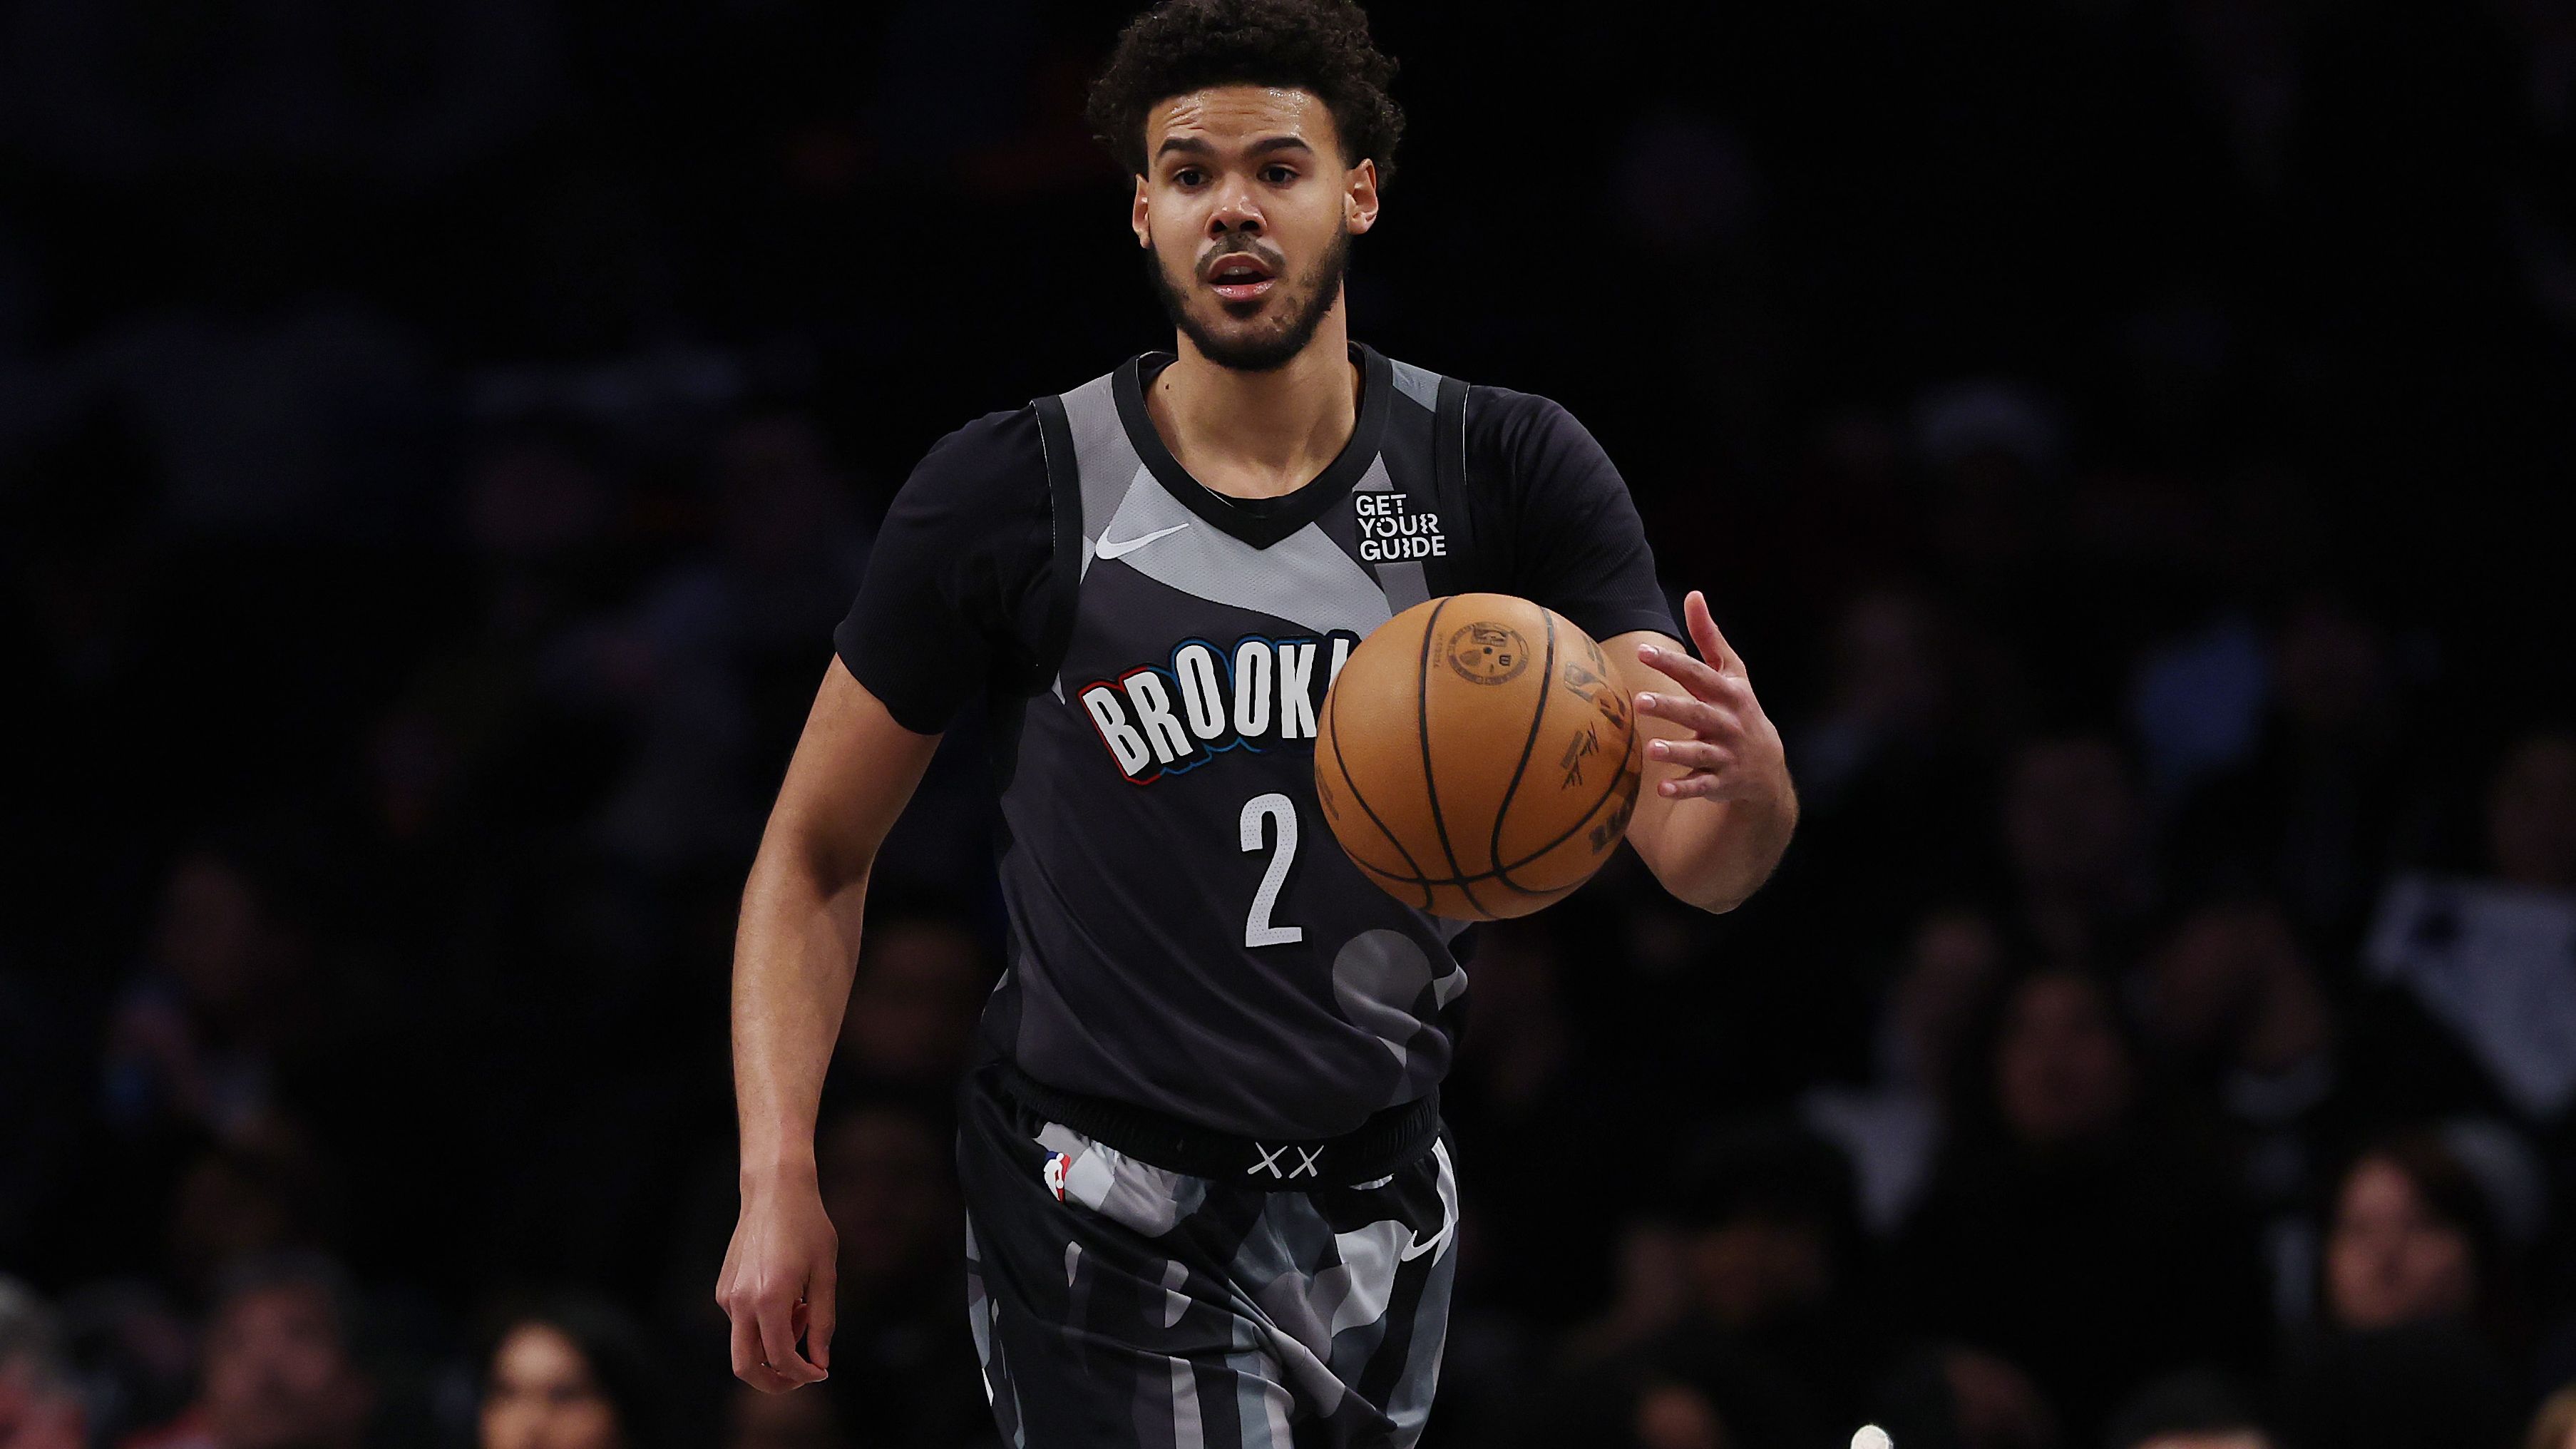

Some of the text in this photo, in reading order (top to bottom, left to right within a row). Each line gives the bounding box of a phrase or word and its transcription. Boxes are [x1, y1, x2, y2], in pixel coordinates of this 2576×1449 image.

[1355, 493, 1407, 516] GET
[1357, 513, 1440, 538] YOUR
[1360, 535, 1447, 561] GUIDE
[1239, 792, 1303, 948] 2
